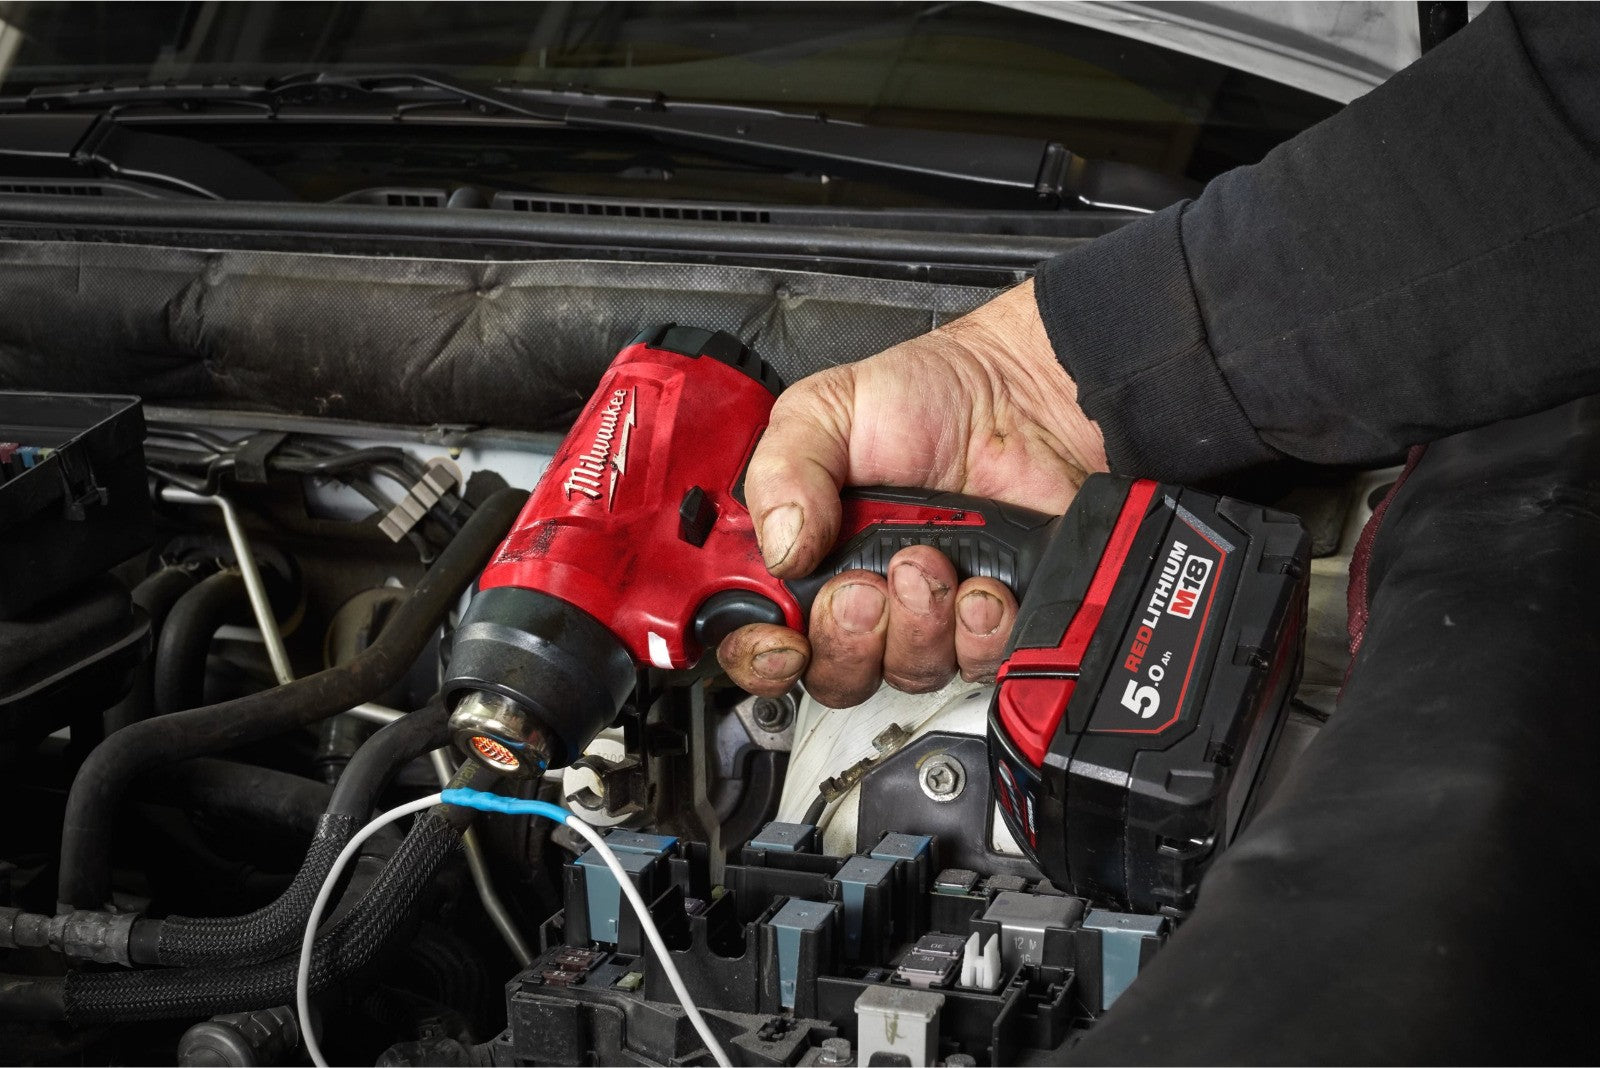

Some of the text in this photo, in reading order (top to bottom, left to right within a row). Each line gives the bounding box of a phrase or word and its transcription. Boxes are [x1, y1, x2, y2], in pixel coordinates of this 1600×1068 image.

[563, 388, 627, 500] Milwaukee
[1124, 540, 1188, 673] REDLITHIUM
[1170, 558, 1208, 616] M18
